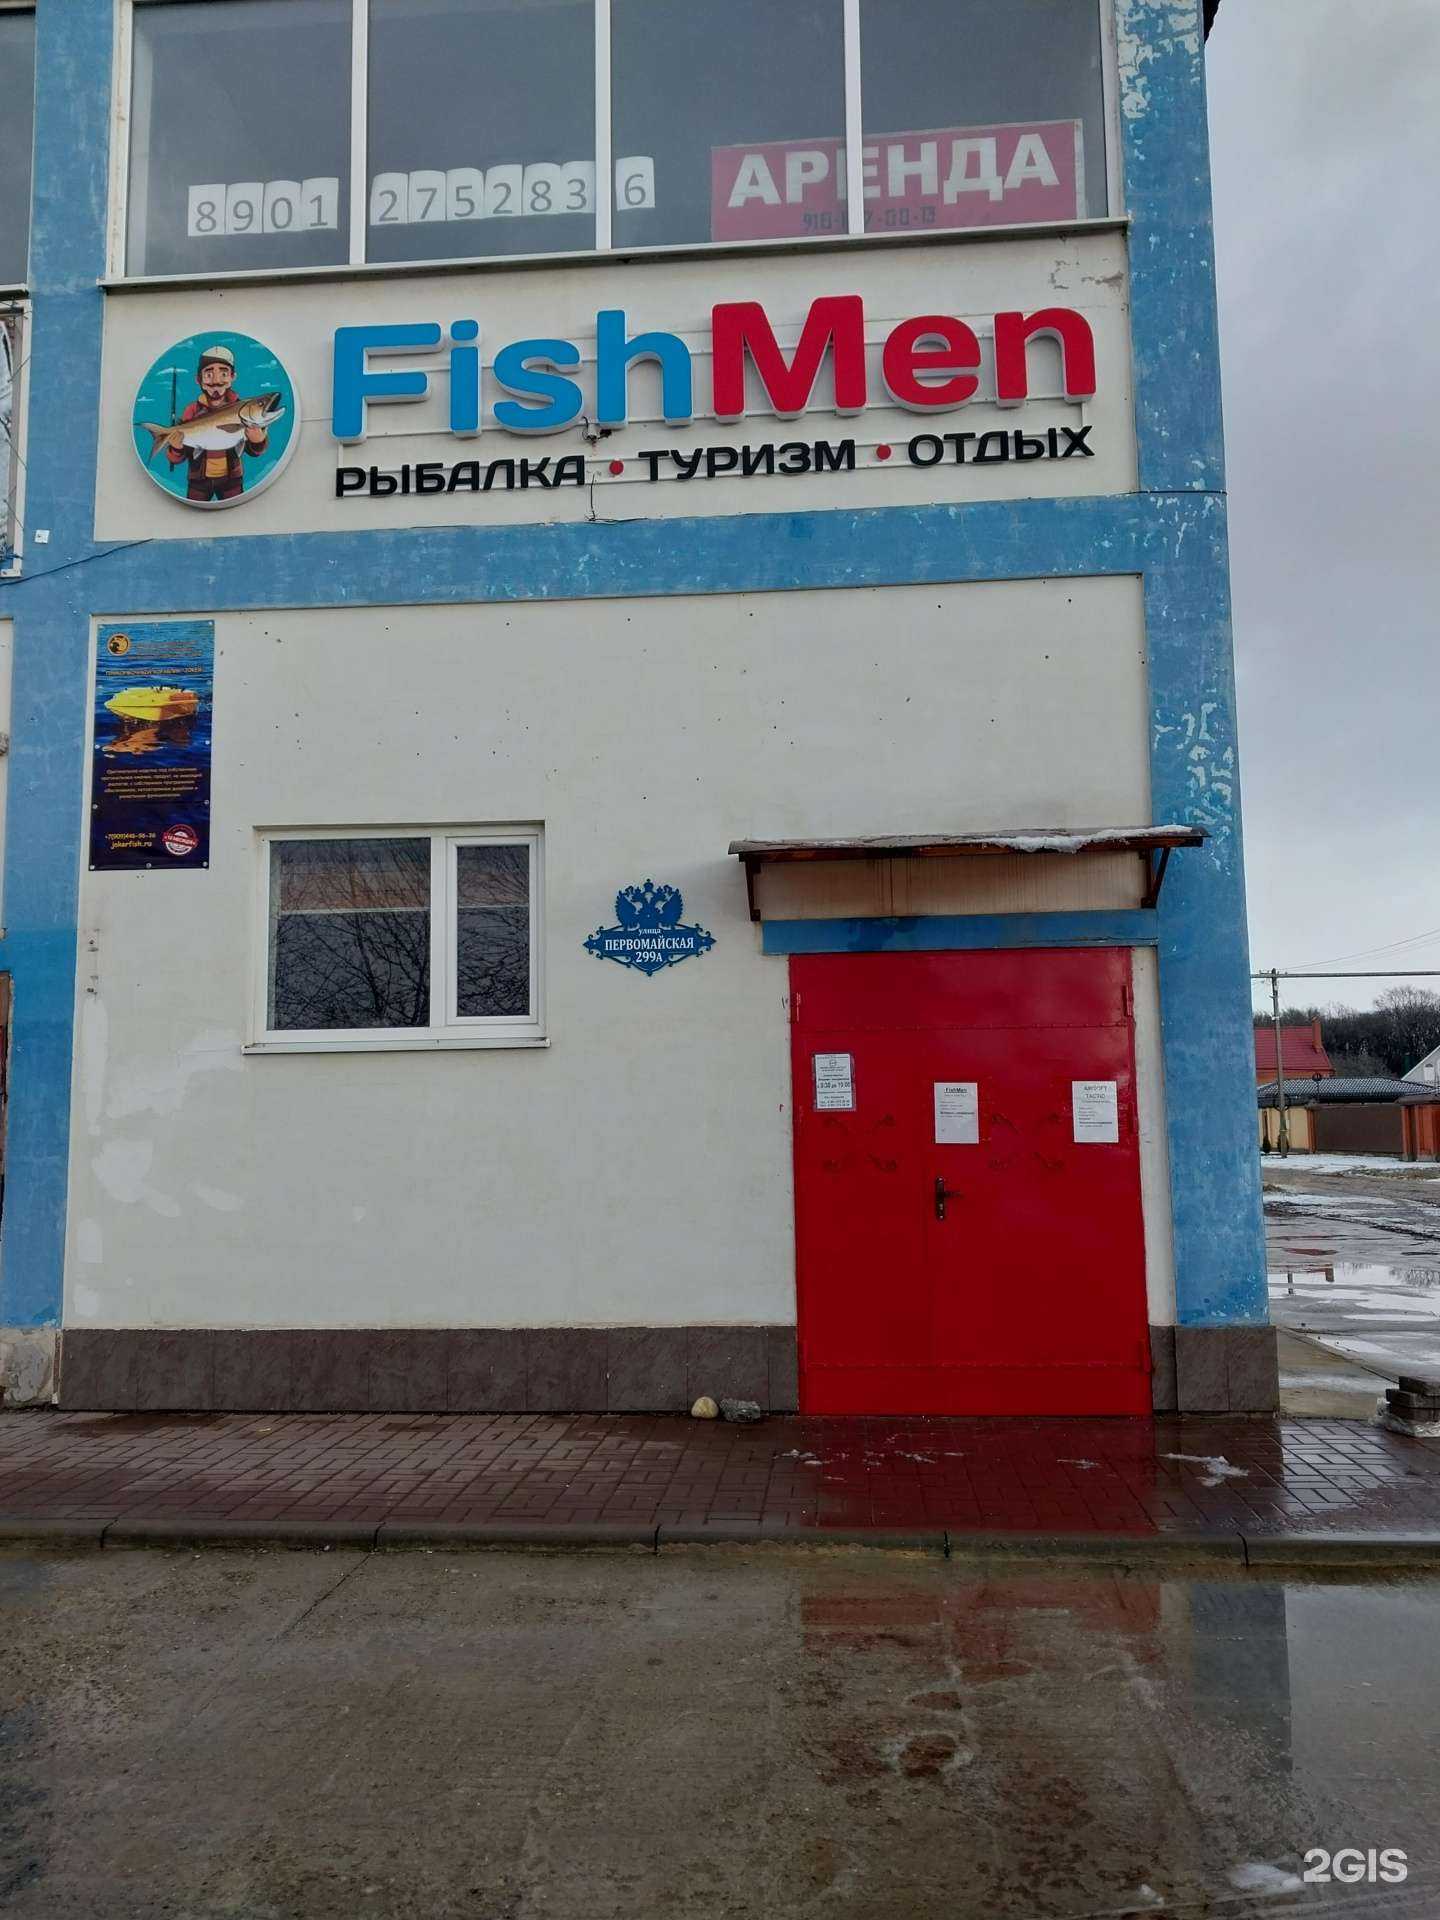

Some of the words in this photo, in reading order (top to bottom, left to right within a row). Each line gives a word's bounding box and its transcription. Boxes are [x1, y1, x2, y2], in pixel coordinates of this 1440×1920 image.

[727, 132, 1061, 208] АРЕНДА
[194, 194, 328, 233] 8901
[331, 294, 1097, 443] FishMen
[335, 454, 586, 498] РЫБАЛКА
[637, 438, 857, 482] ТУРИЗМ
[907, 424, 1096, 468] ОТДЫХ
[604, 936, 695, 951] ПЕРВОМАЙСКАЯ
